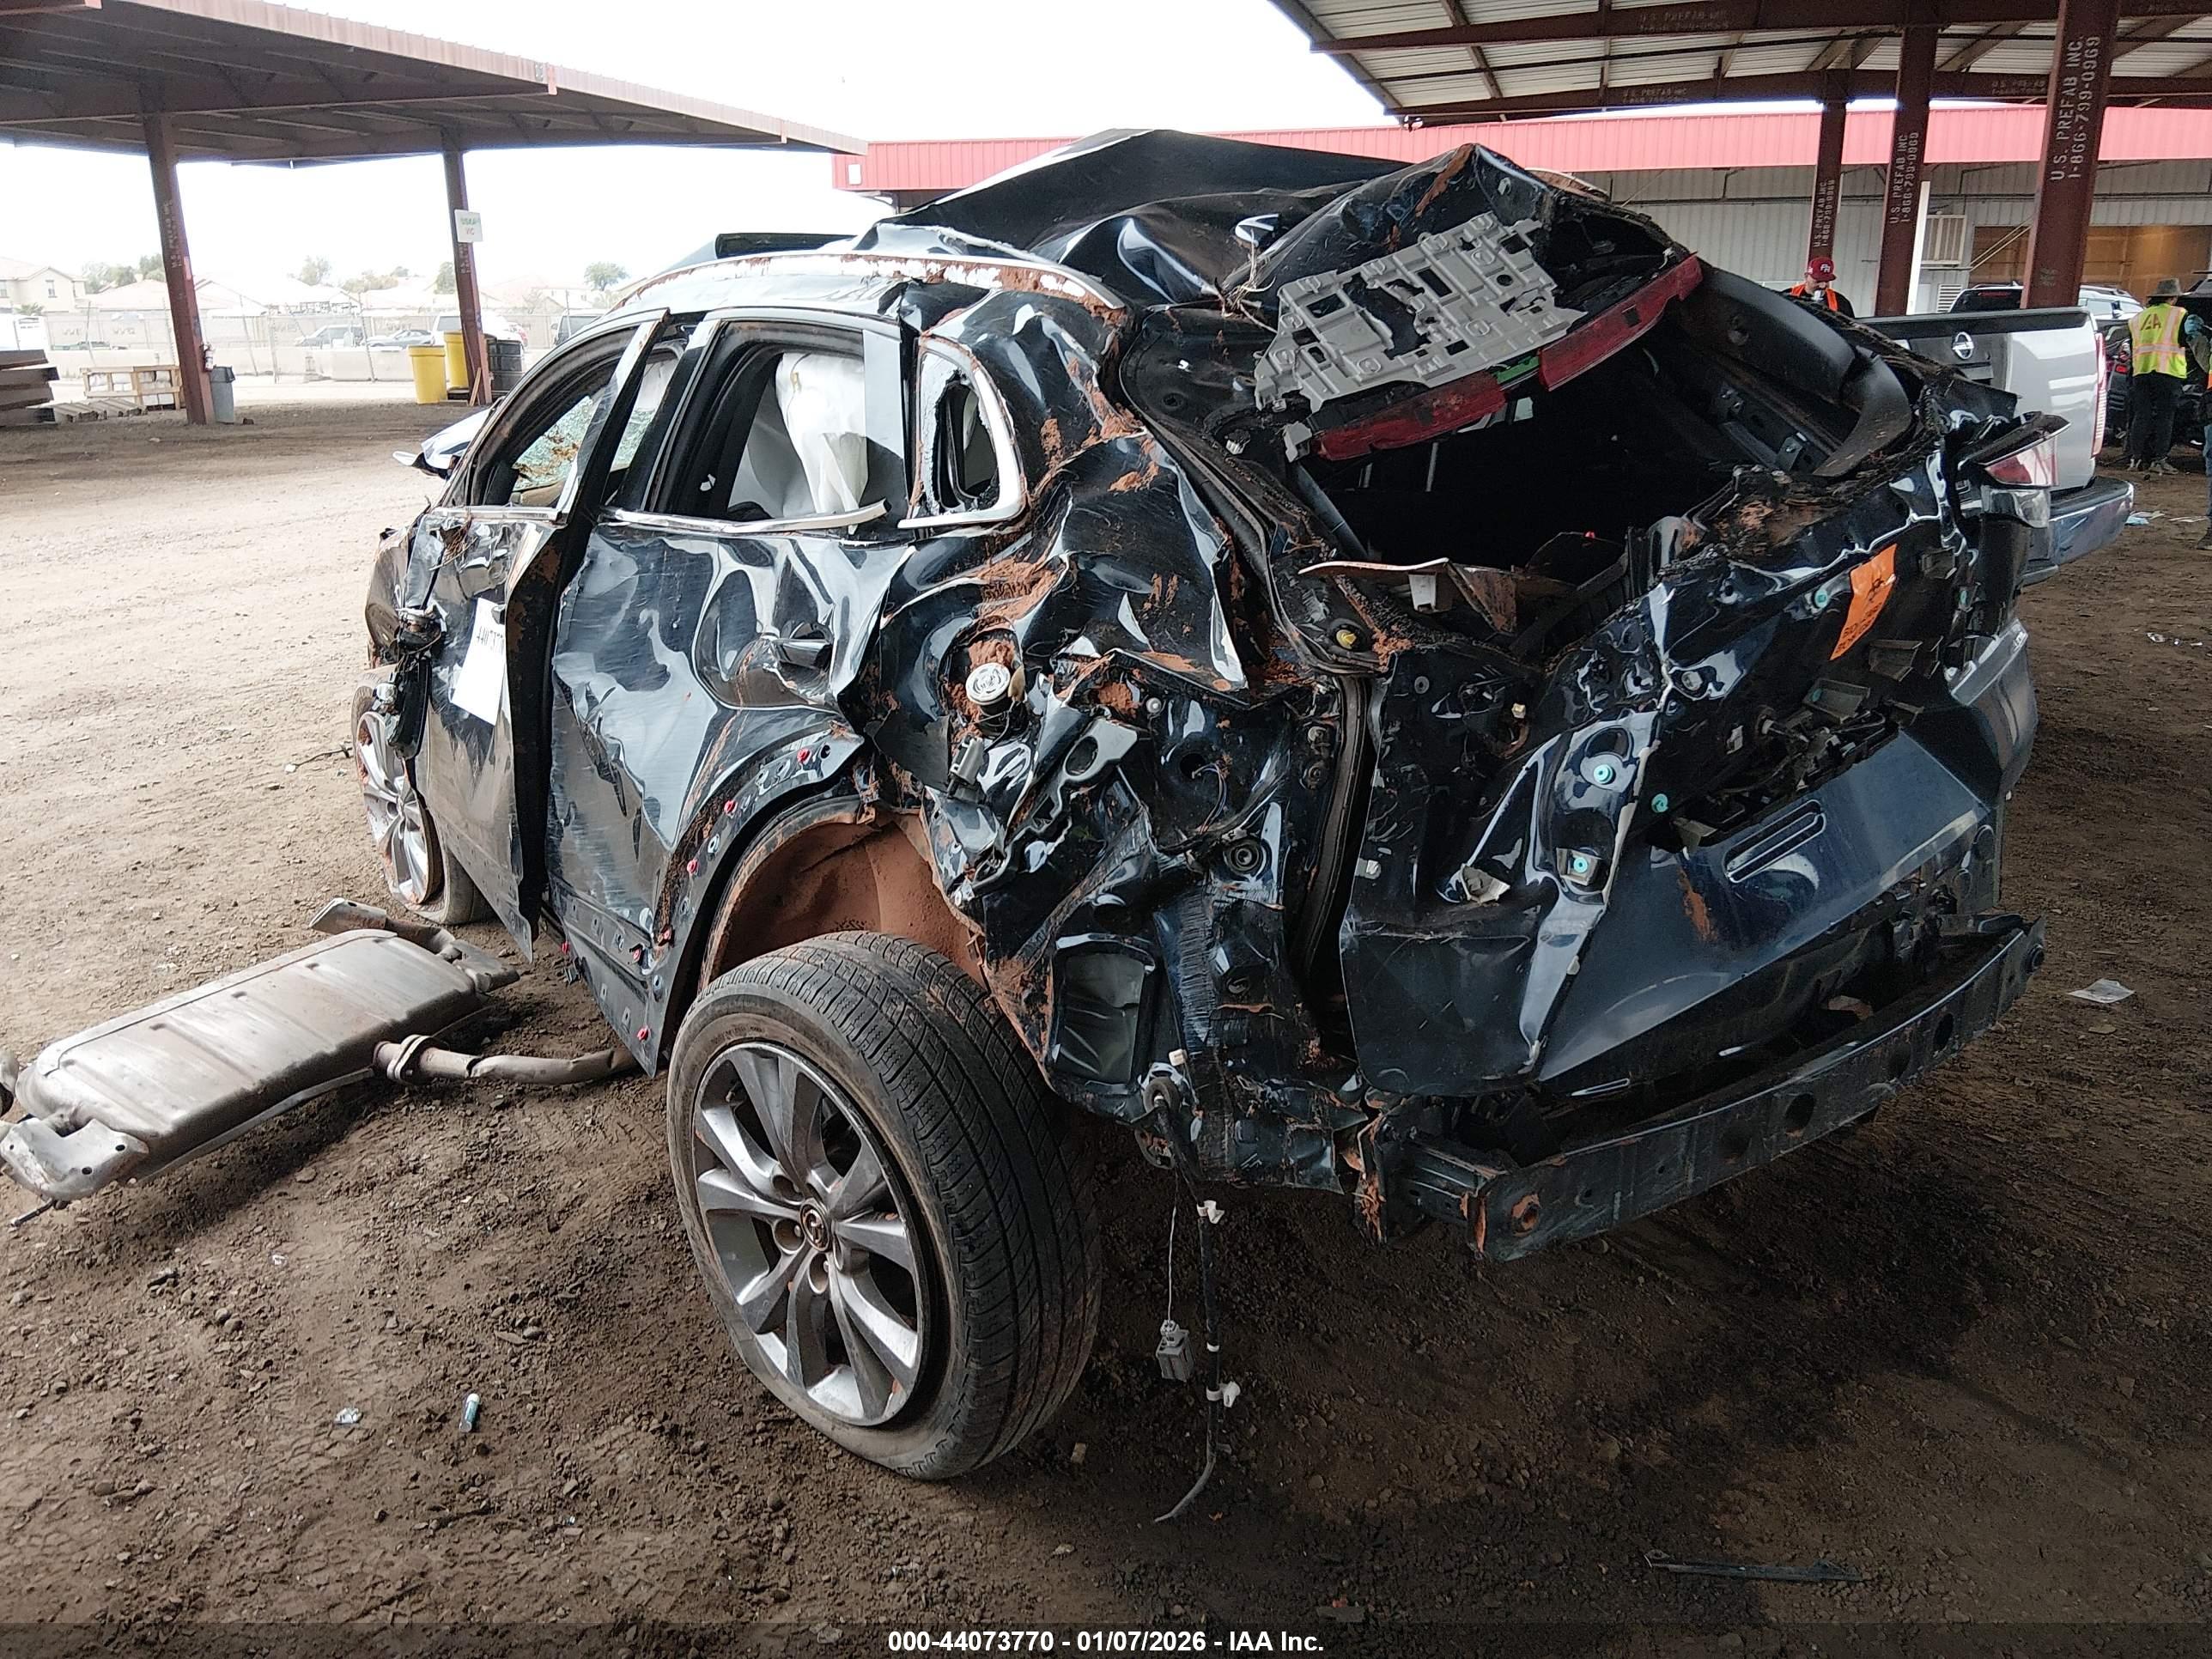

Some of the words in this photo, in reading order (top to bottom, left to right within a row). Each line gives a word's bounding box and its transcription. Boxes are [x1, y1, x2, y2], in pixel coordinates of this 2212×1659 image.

[2065, 35, 2085, 69] INC.
[2056, 76, 2078, 140] PREFAB
[2068, 36, 2100, 179] 1-866-799-0969
[2050, 149, 2069, 179] U.S.
